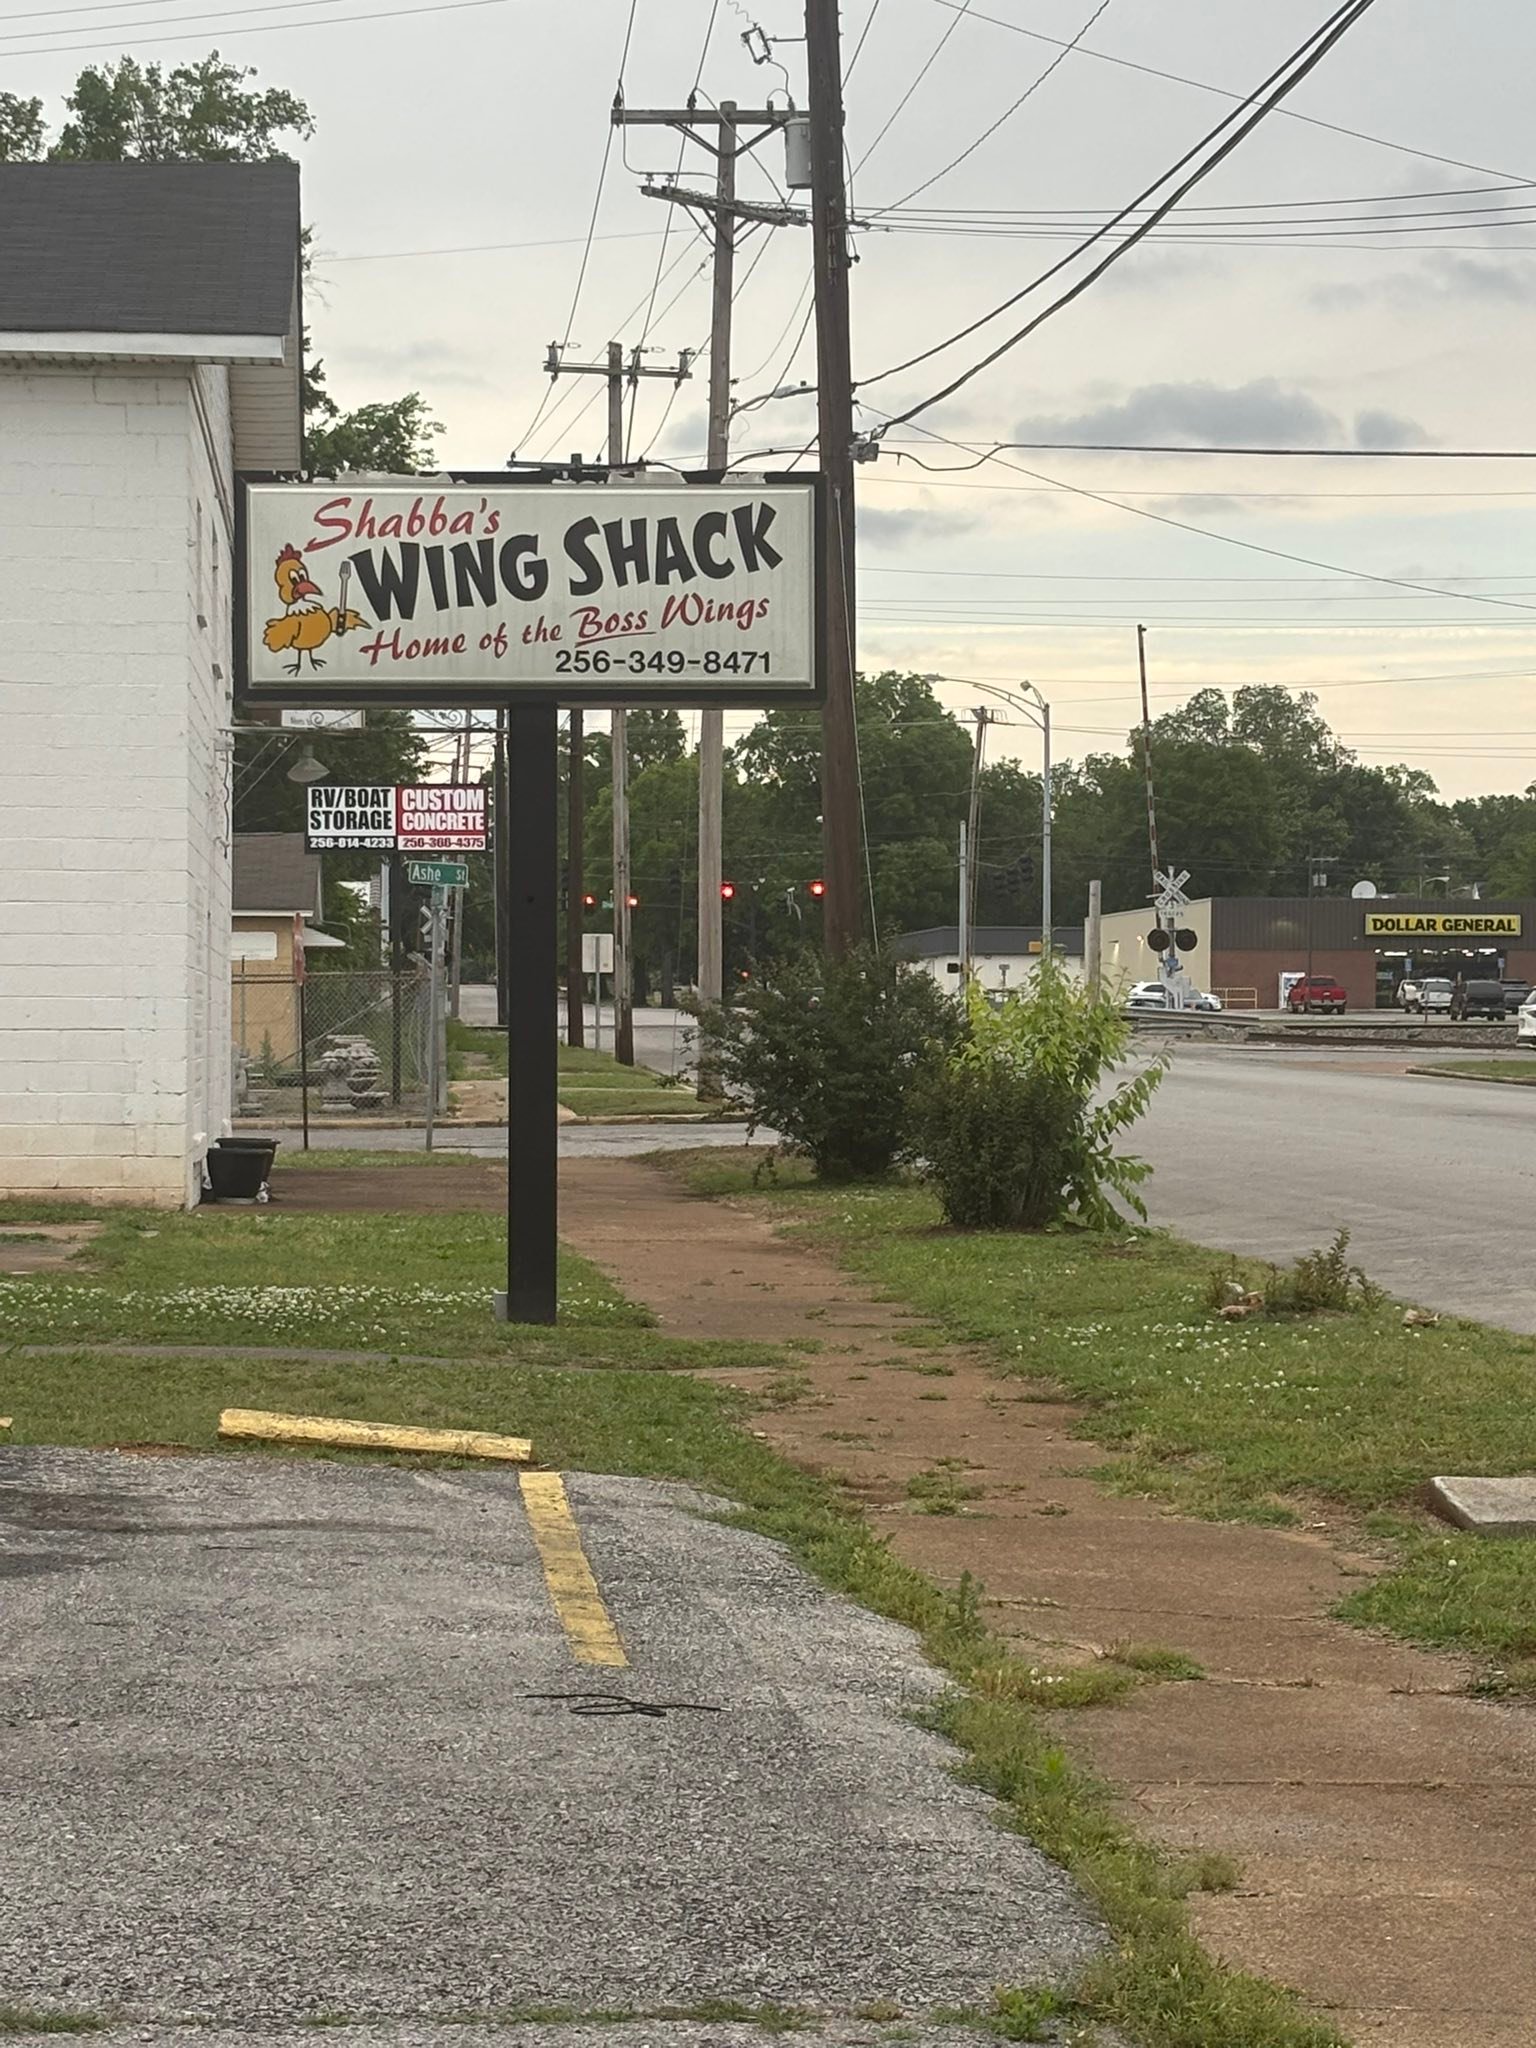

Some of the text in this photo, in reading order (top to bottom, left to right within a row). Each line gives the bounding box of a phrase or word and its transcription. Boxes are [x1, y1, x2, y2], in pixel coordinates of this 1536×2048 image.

[304, 496, 500, 552] Shabba's
[347, 501, 783, 621] WING SHACK
[359, 592, 770, 666] Home of the Boss Wings
[555, 650, 770, 674] 256-349-8471
[311, 788, 391, 808] RV/BOAT
[402, 788, 484, 811] CUSTOM
[310, 810, 393, 830] STORAGE
[402, 812, 485, 831] CONCRETE
[412, 864, 465, 881] Ashe St
[1371, 918, 1516, 932] DOLLAR GENERAL
